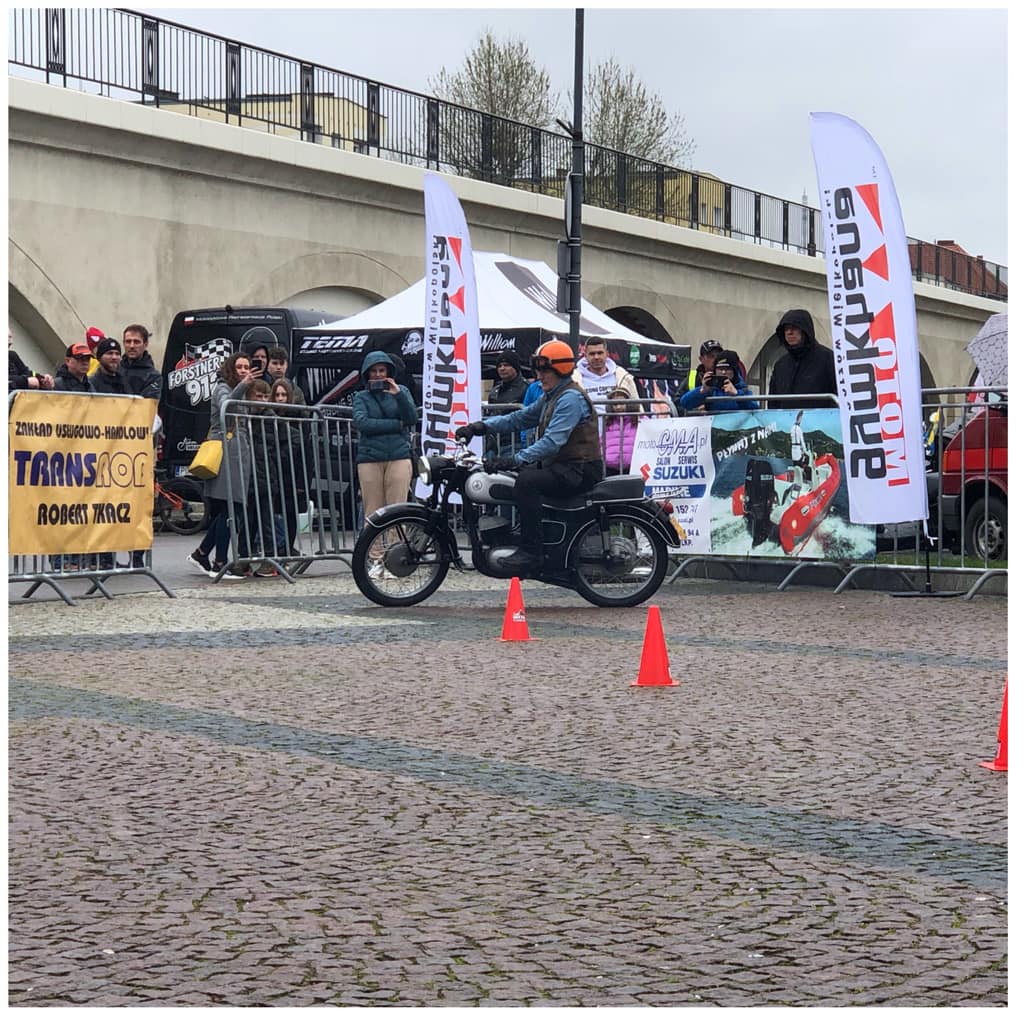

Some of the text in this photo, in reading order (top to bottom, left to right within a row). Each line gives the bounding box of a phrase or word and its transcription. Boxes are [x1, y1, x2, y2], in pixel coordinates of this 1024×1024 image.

[15, 421, 149, 440] ZAKŁAD USŁUGOWO-HANDLOW
[678, 456, 698, 465] SERWIS
[653, 465, 706, 480] SUZUKI
[37, 502, 131, 526] ROBERT TKACZ
